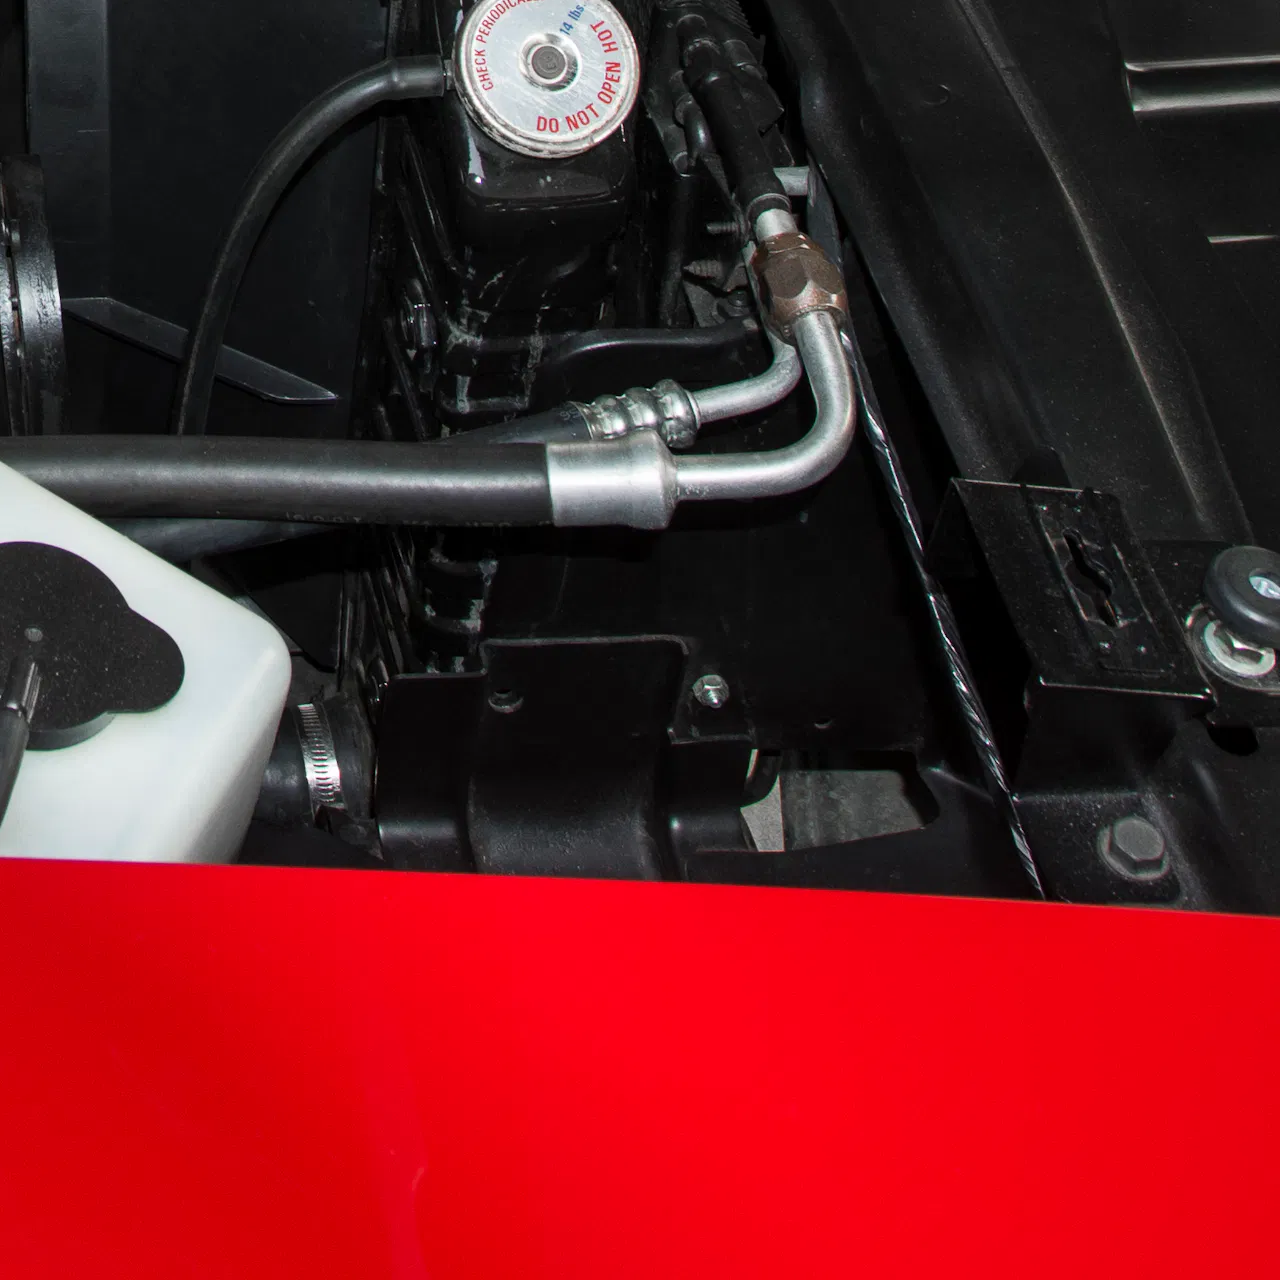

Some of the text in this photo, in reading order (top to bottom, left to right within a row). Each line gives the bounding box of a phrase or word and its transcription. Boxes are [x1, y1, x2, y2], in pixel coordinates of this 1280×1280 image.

[559, 21, 573, 36] 14
[475, 49, 494, 91] CHECK
[536, 20, 621, 134] DO NOT OPEN HOT
